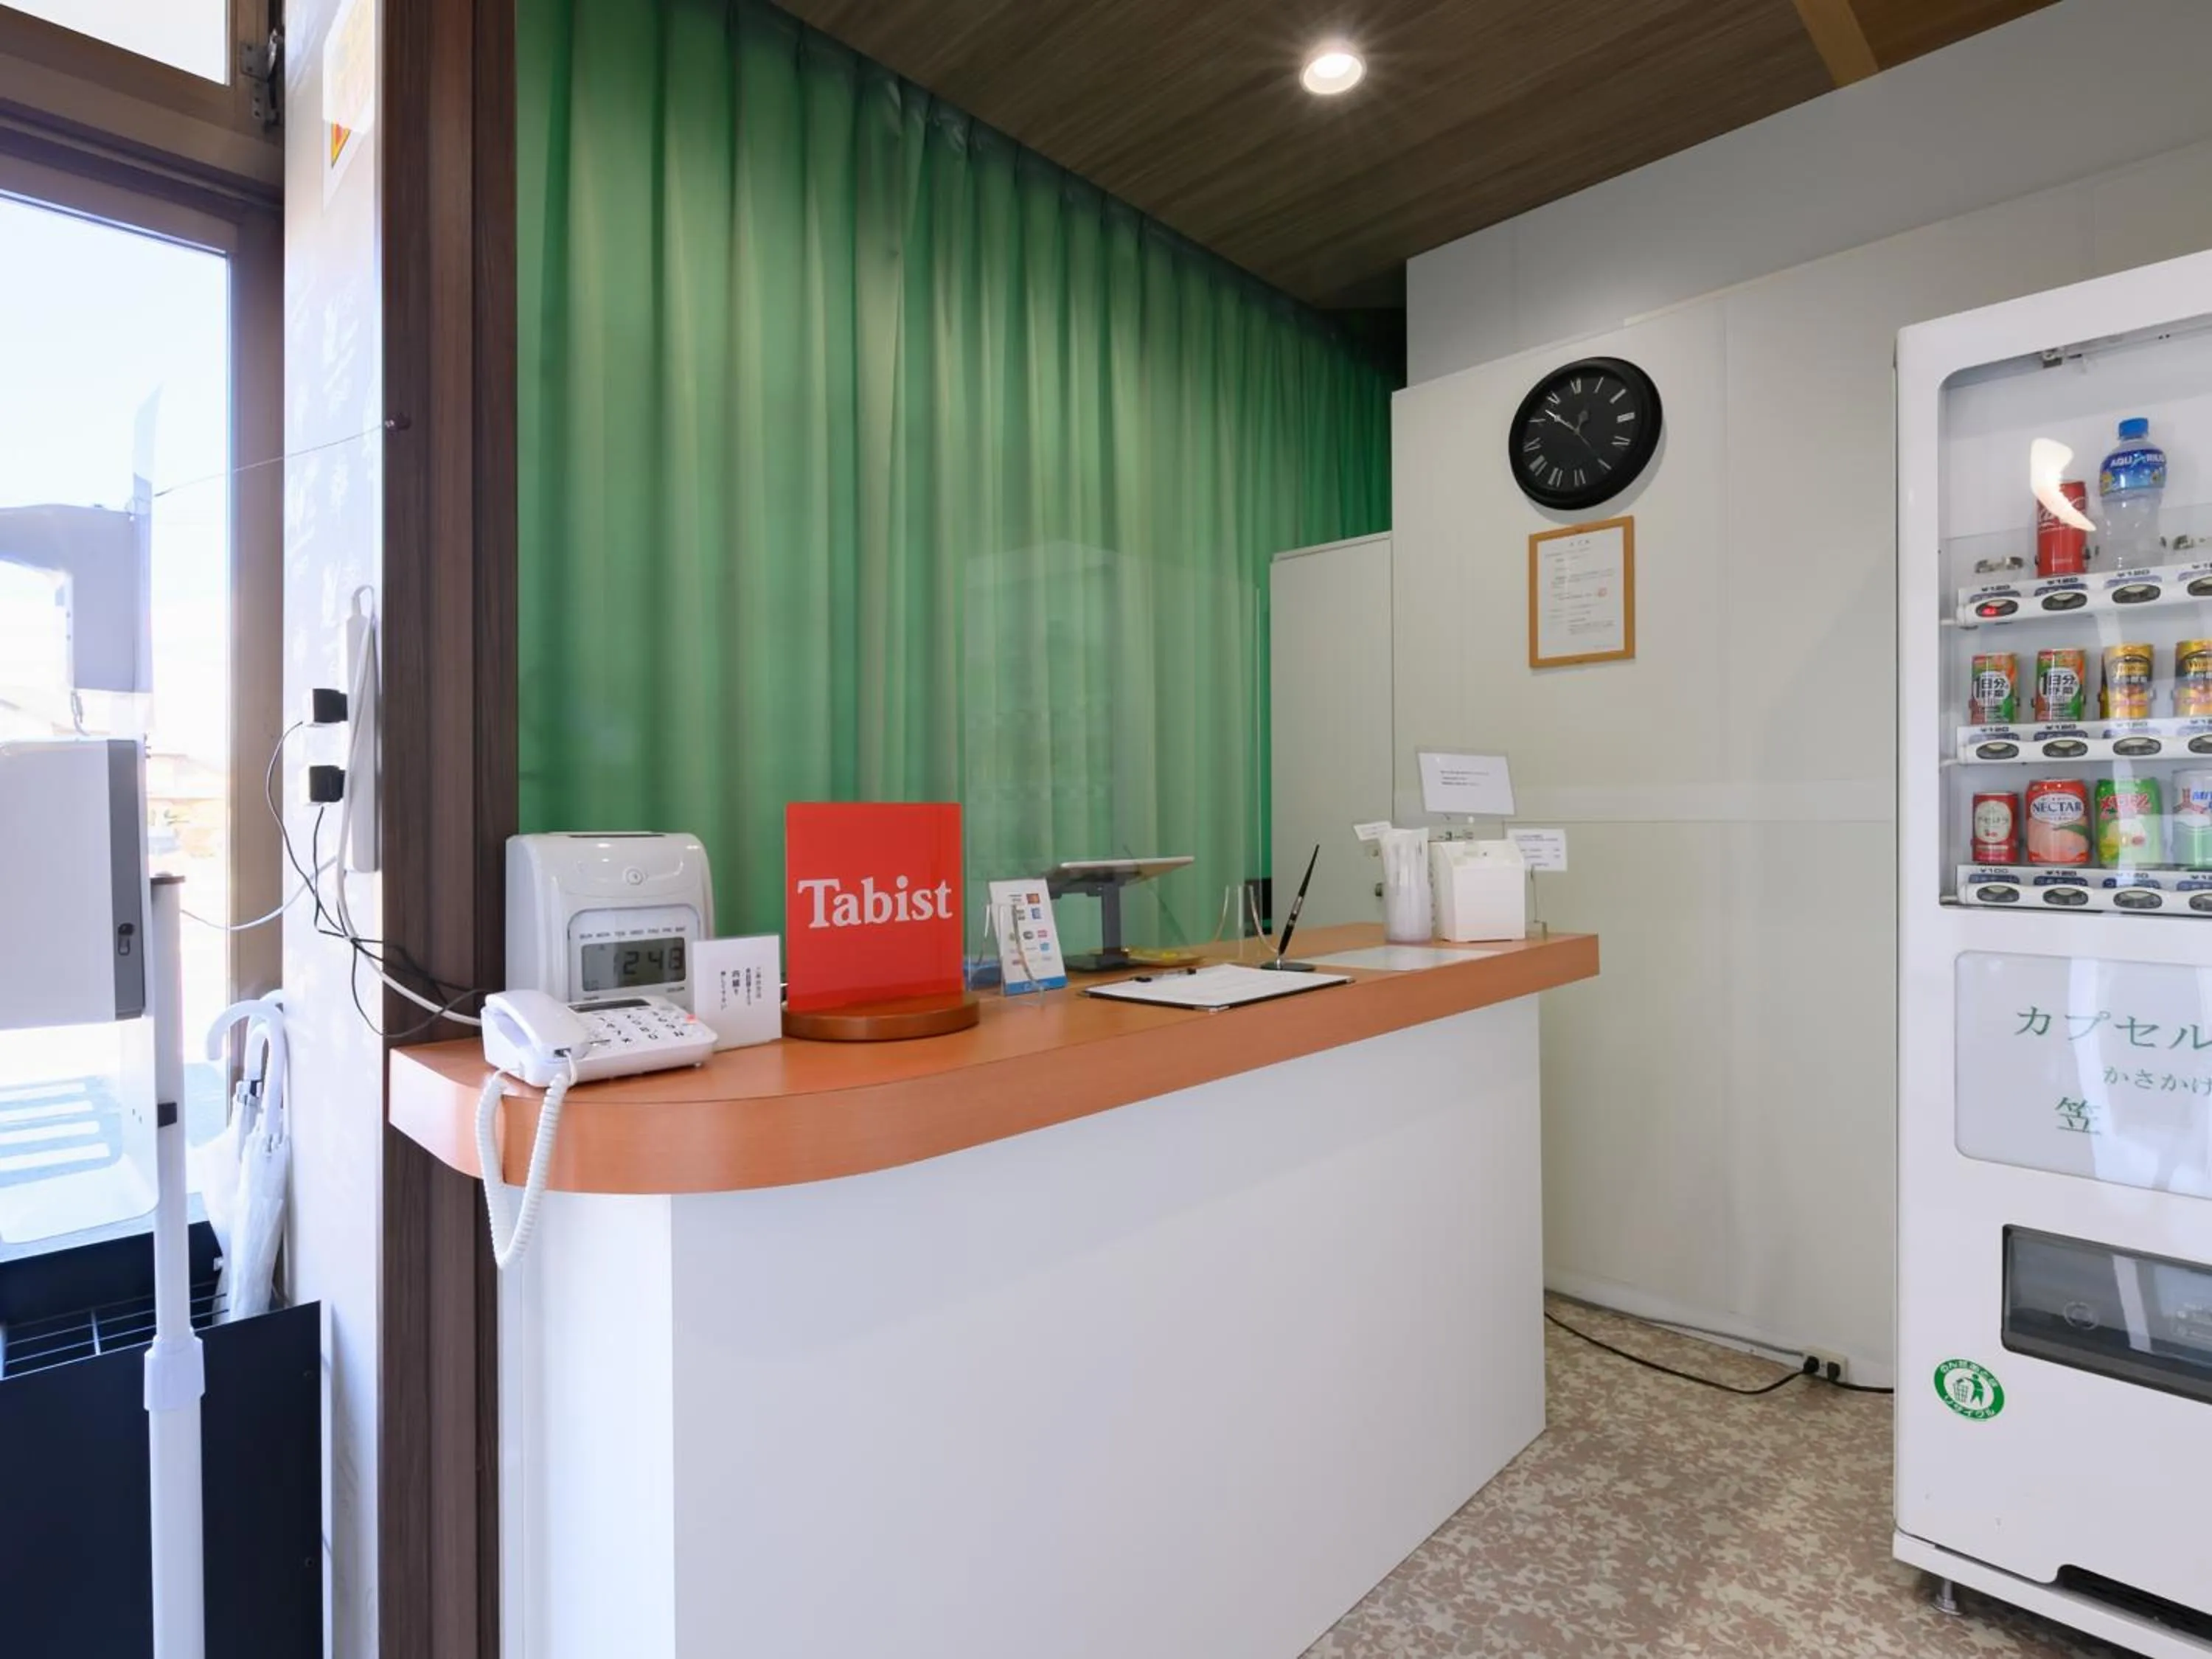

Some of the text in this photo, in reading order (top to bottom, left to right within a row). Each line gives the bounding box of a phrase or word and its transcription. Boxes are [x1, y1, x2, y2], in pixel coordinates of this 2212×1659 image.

[2032, 801, 2082, 813] NECTAR
[797, 874, 953, 928] Tabist
[2014, 1006, 2212, 1050] カプセル
[2103, 1066, 2212, 1096] かさかけ
